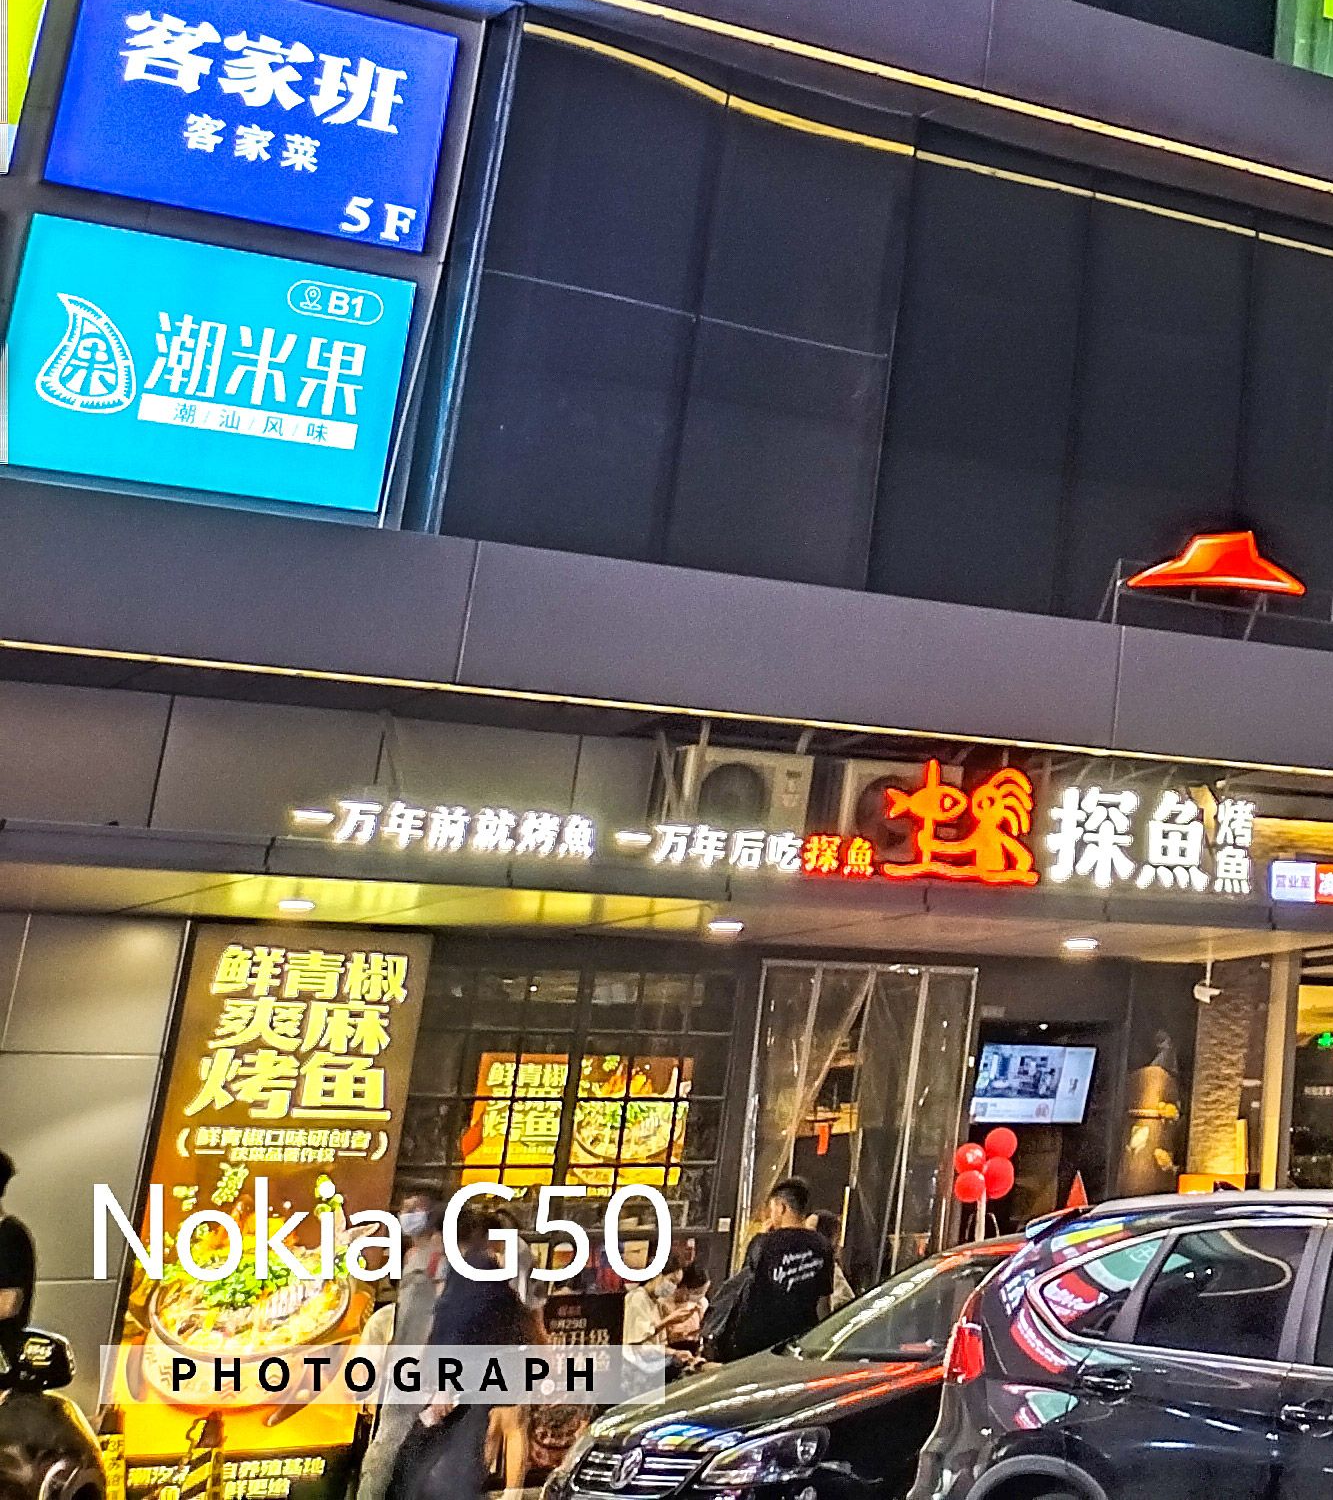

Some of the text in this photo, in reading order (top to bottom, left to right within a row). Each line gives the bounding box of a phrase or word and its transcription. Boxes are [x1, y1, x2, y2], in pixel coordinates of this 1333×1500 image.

[118, 8, 409, 136] 客家班
[183, 112, 321, 175] 客家菜
[327, 290, 365, 319] B1
[143, 311, 368, 417] 潮米果
[210, 945, 409, 1003] 鲜青椒
[208, 999, 391, 1055] 爽麻
[184, 1052, 392, 1121] 烤鱼
